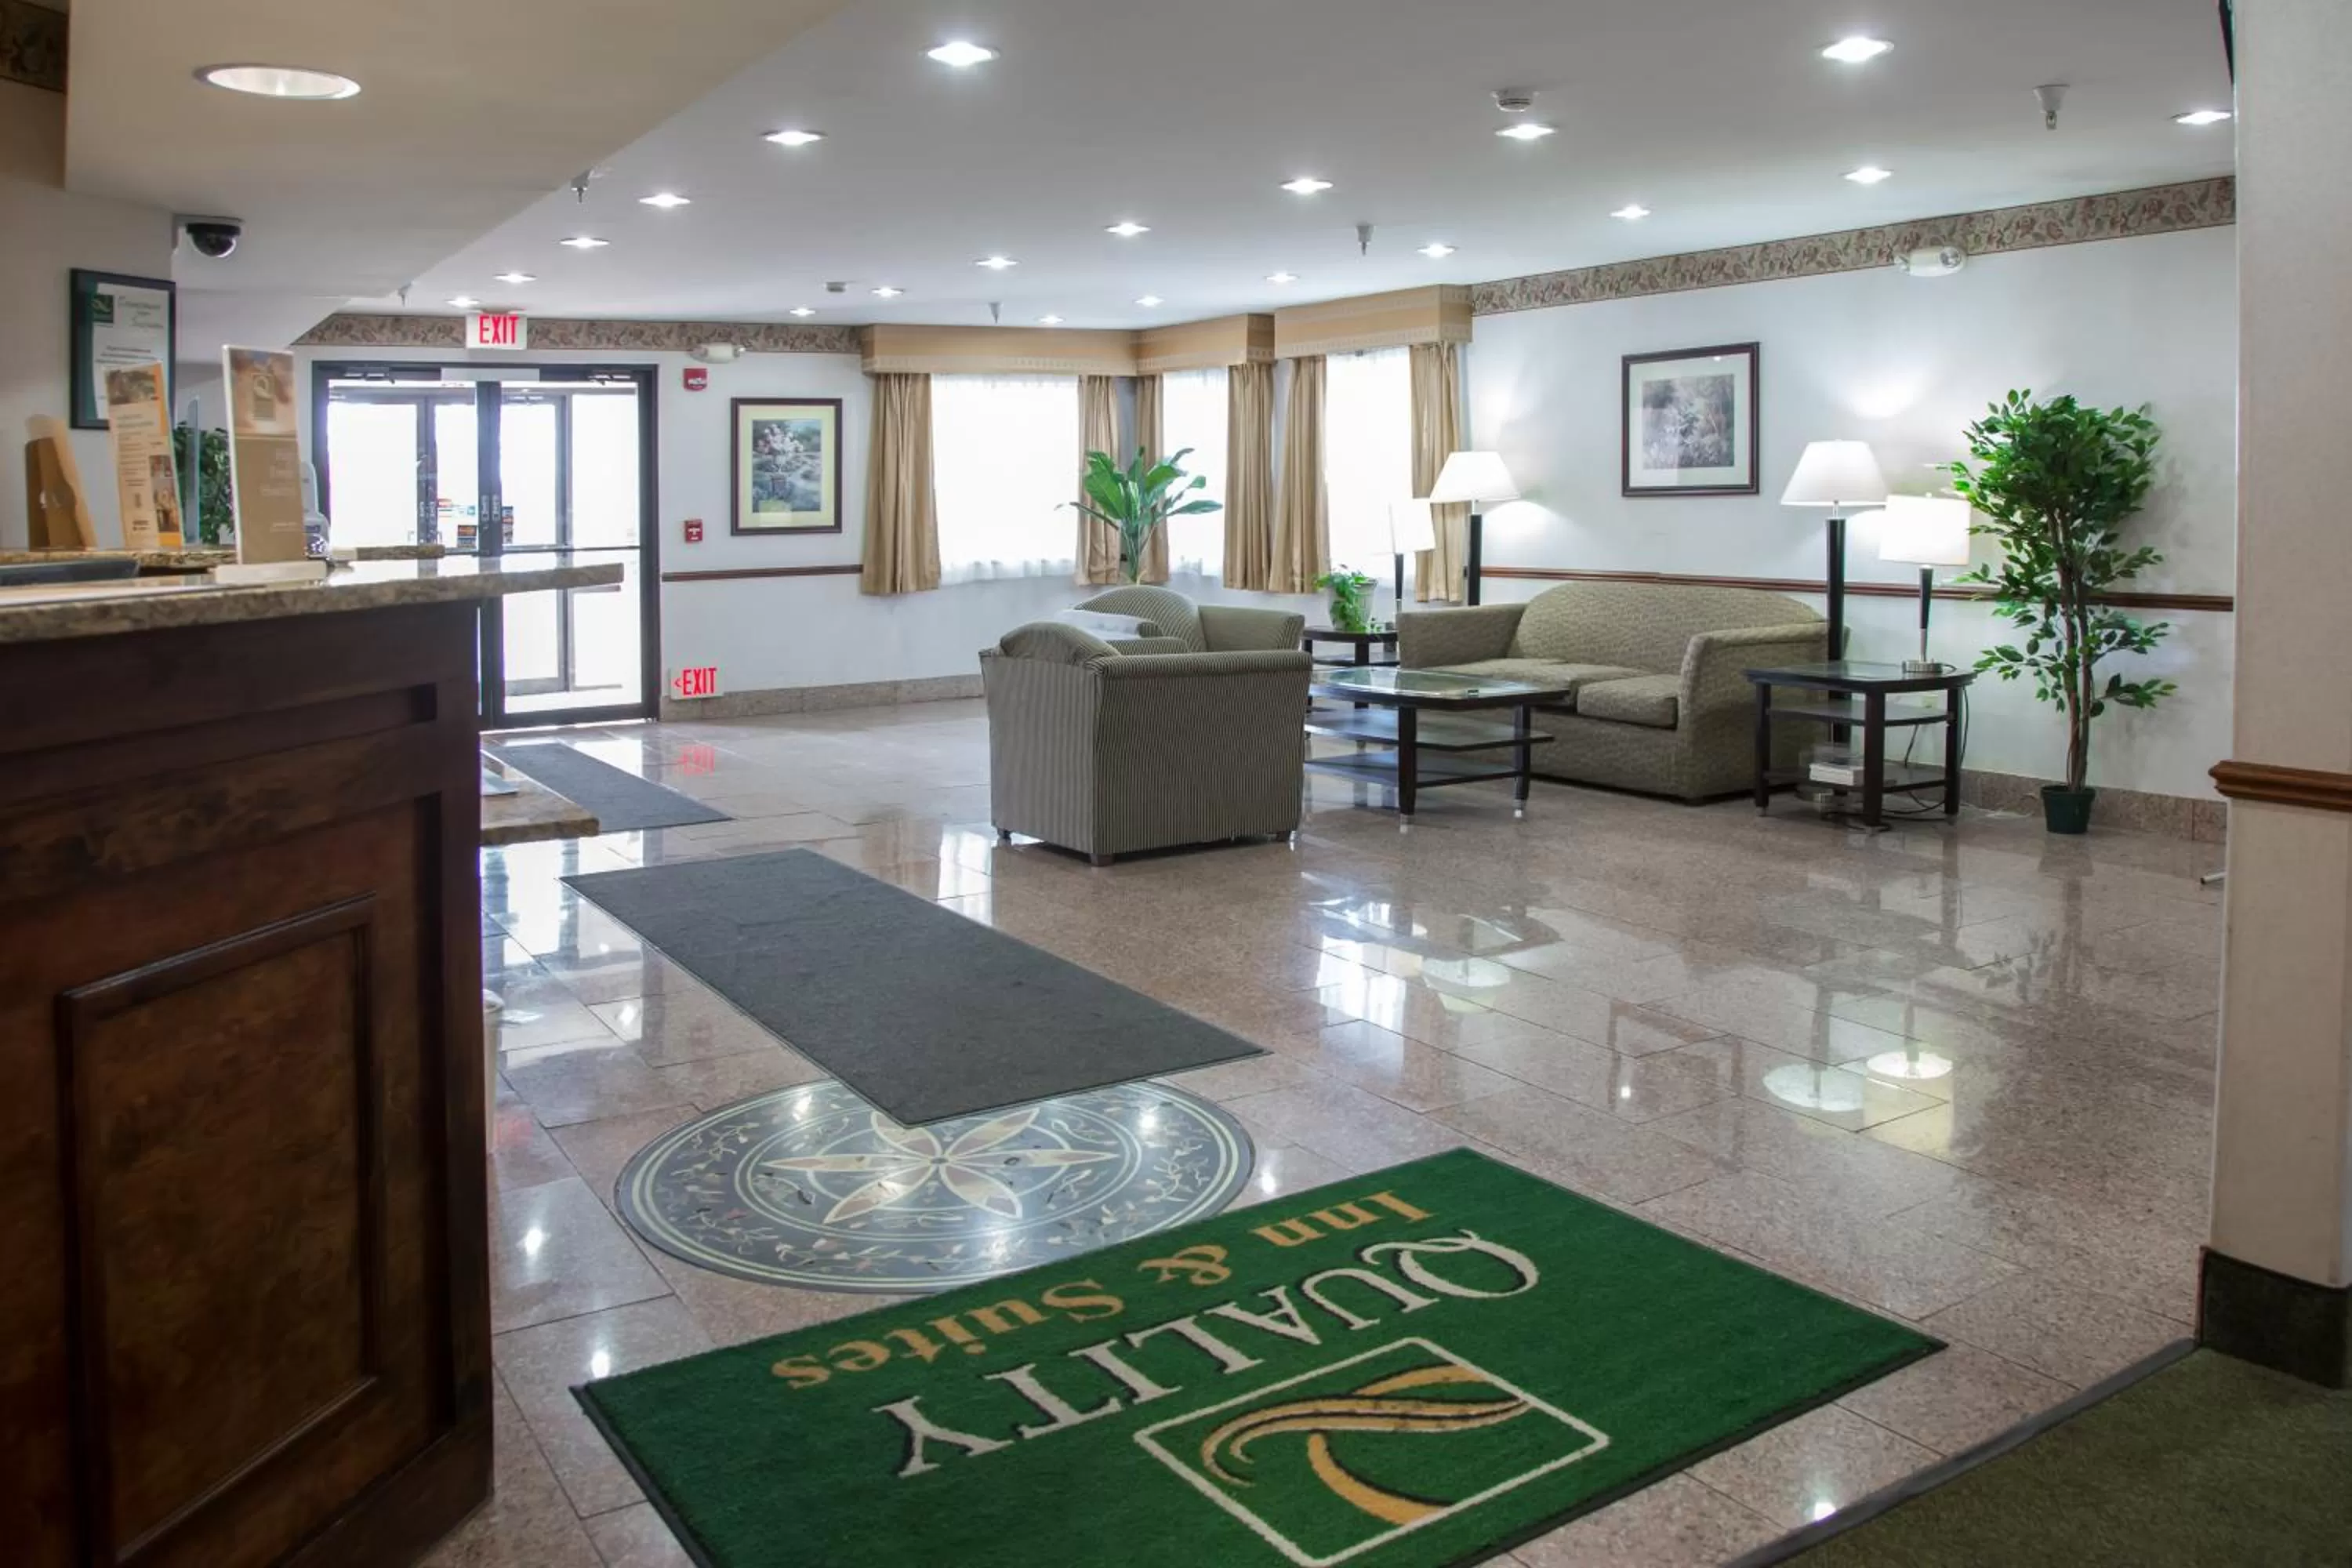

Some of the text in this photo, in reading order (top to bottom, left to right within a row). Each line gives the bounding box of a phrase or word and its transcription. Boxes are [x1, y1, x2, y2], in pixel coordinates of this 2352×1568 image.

[479, 314, 520, 344] EXIT
[682, 667, 717, 695] EXIT
[771, 1189, 1436, 1390] Inn & Suites
[870, 1229, 1540, 1478] QUALITY
